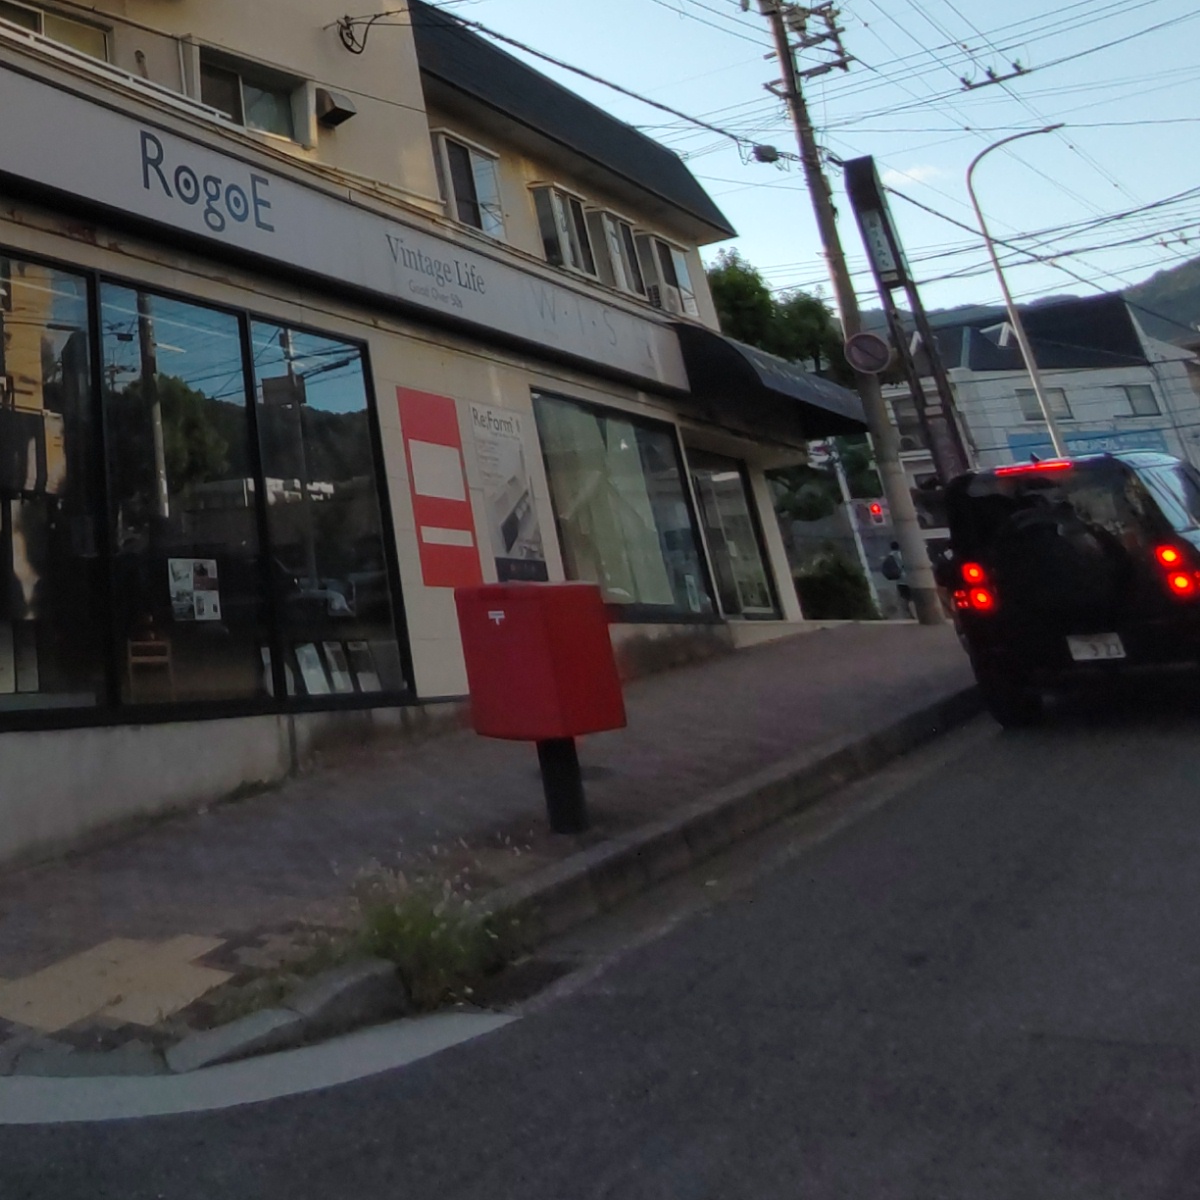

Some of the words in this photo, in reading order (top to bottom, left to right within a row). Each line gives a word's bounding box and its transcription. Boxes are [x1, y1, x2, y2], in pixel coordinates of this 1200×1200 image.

[139, 129, 275, 233] RogoE
[385, 233, 452, 288] Vintage
[453, 259, 486, 295] Life
